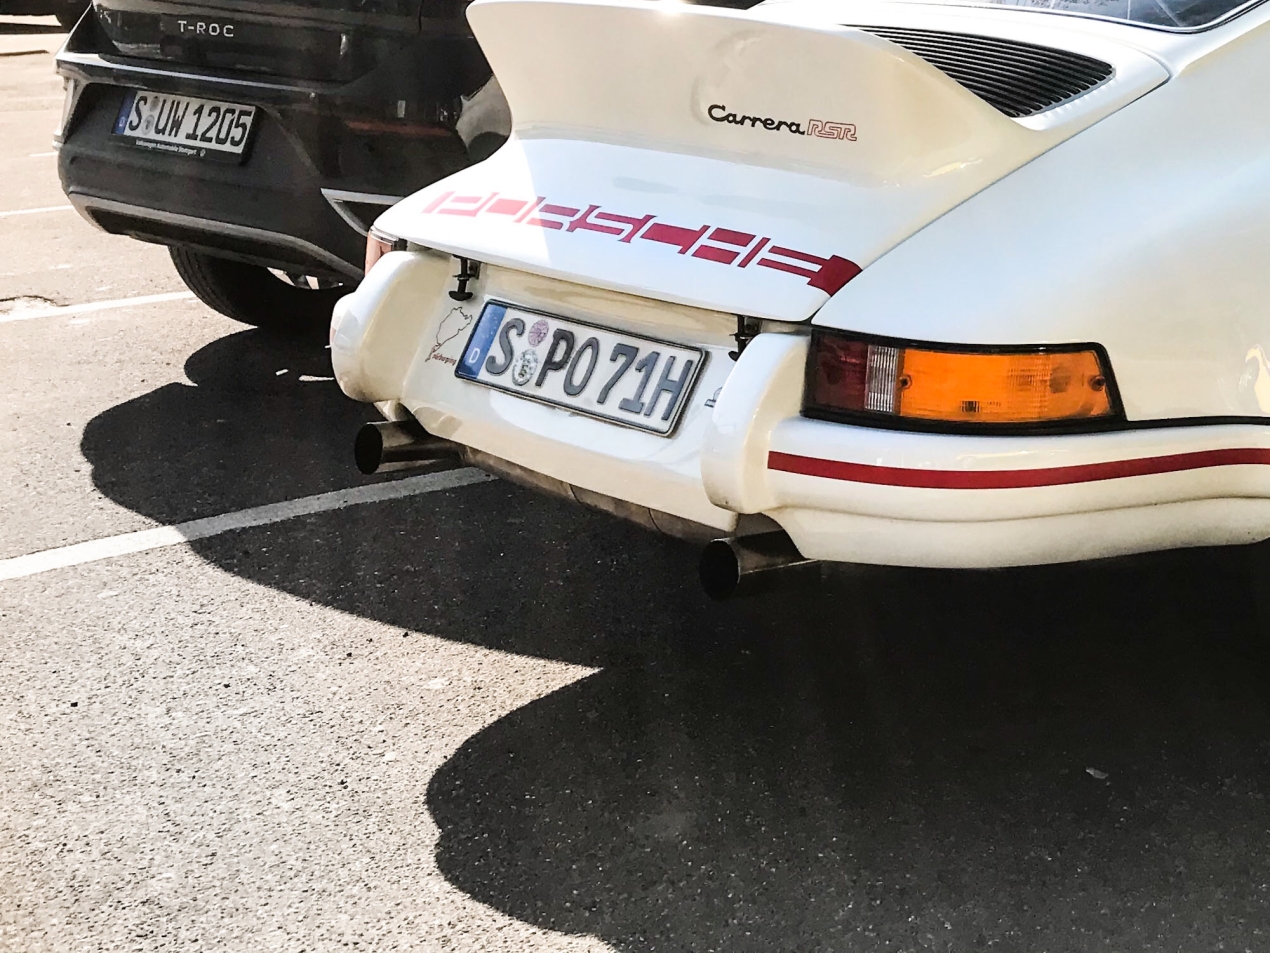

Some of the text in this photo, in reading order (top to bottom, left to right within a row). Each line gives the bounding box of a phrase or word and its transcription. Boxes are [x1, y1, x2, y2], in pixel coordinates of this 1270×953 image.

[178, 20, 234, 37] T-ROC
[128, 95, 253, 147] S UW 1205
[707, 103, 858, 142] Carrera RSR
[485, 317, 525, 376] S
[597, 342, 694, 421] 71H
